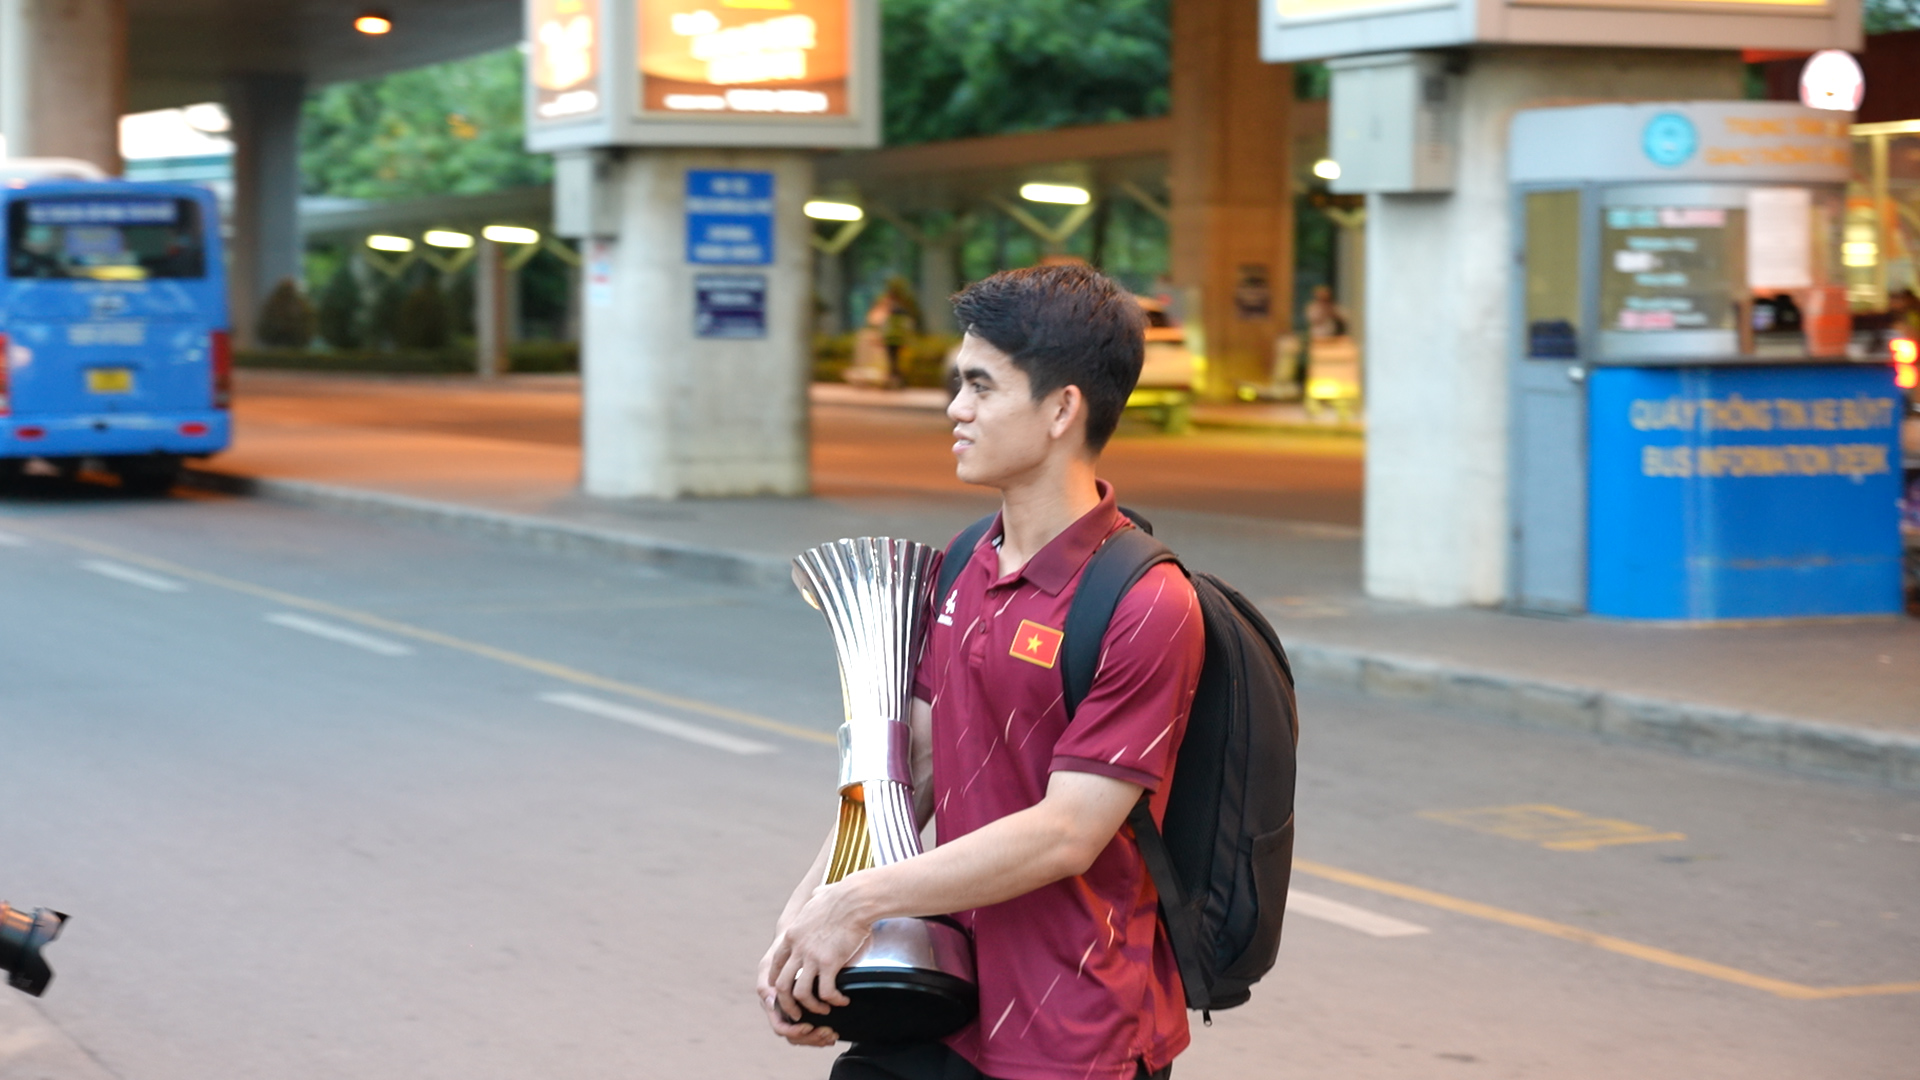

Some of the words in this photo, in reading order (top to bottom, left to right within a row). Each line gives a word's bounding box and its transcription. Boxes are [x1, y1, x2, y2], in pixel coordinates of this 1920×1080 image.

[1641, 445, 1692, 477] BUS
[1697, 445, 1831, 477] INFORMATION
[1835, 445, 1889, 477] DESK
